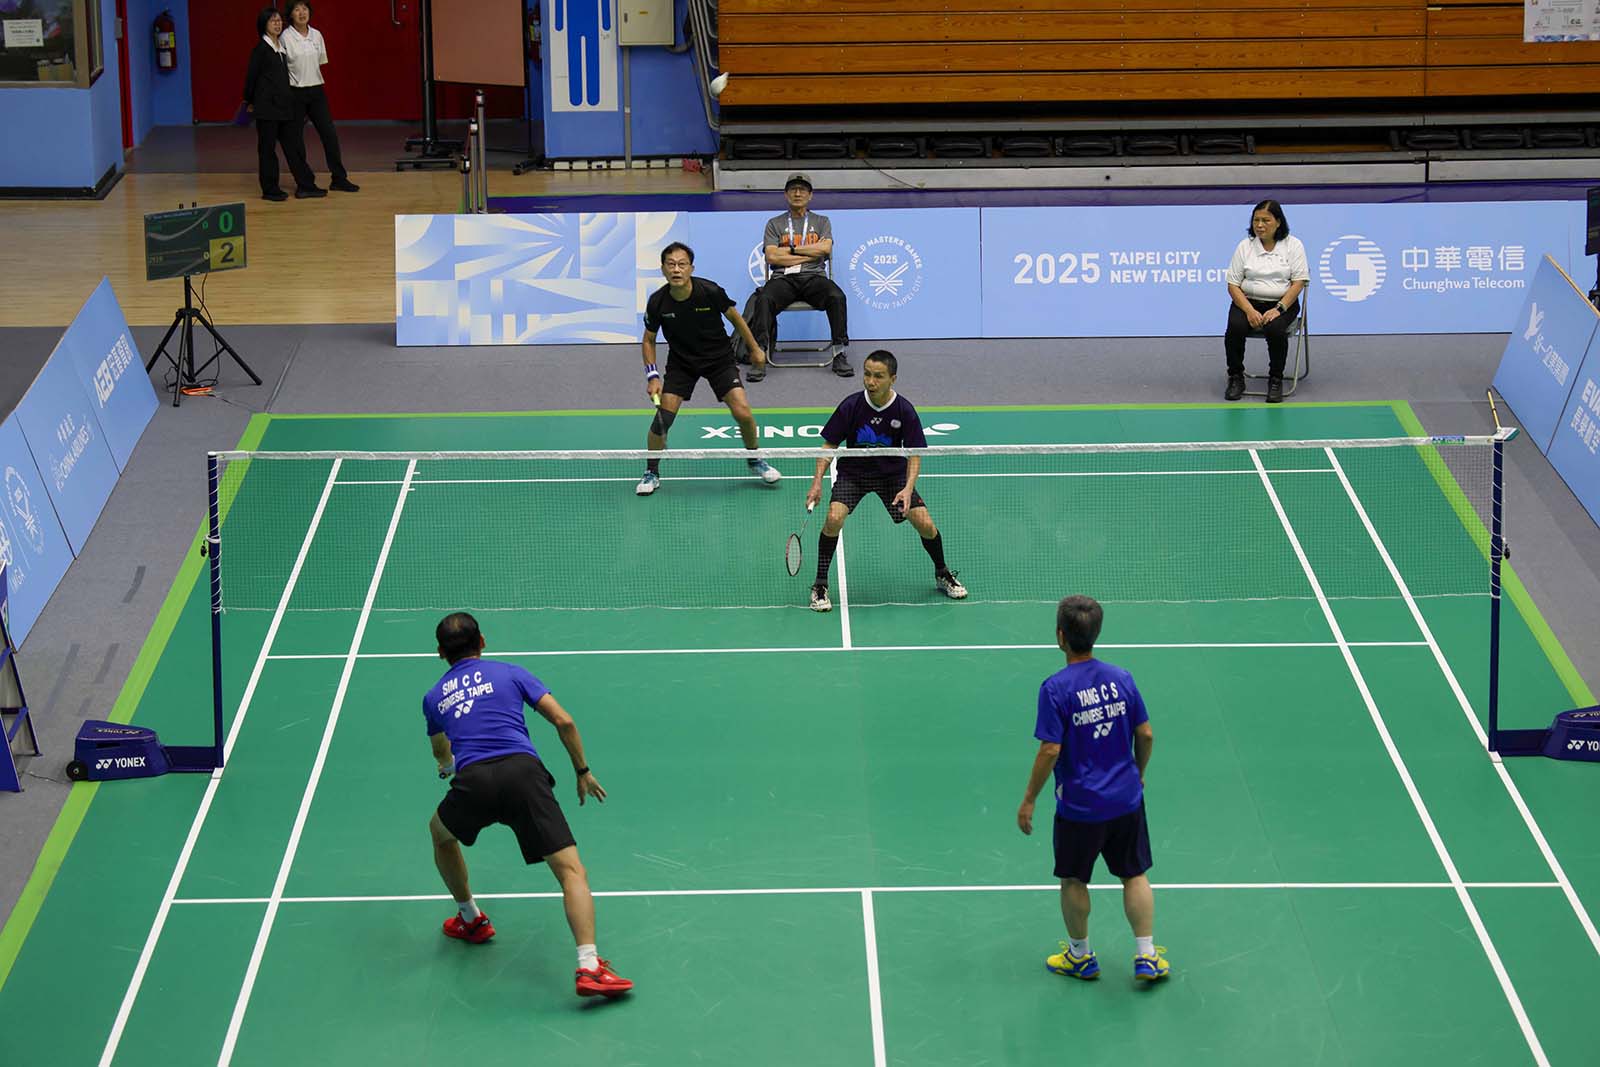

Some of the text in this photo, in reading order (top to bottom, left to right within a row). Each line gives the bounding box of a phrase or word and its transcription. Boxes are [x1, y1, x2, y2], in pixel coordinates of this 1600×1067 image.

[219, 211, 234, 233] 0
[220, 241, 235, 264] 2
[849, 236, 923, 271] WORLD MASTERS GAMES
[873, 255, 898, 264] 2025
[1109, 251, 1201, 265] TAIPEI CITY
[1402, 245, 1526, 273] 中華電信
[1014, 253, 1101, 285] 2025
[1110, 268, 1231, 284] NEW TAIPEI CIT
[850, 277, 865, 300] TAIPEI
[872, 301, 890, 310] NEW
[892, 292, 915, 309] TAIPEI
[1402, 276, 1525, 293] Chunghwa Telecom
[442, 671, 482, 696] SIM C C
[1076, 681, 1119, 707] YANG C S
[437, 682, 494, 715] CHINESE TAIPEI
[1072, 706, 1105, 726] CHINESE
[1586, 740, 1600, 752] YO
[114, 756, 146, 768] YONEX
